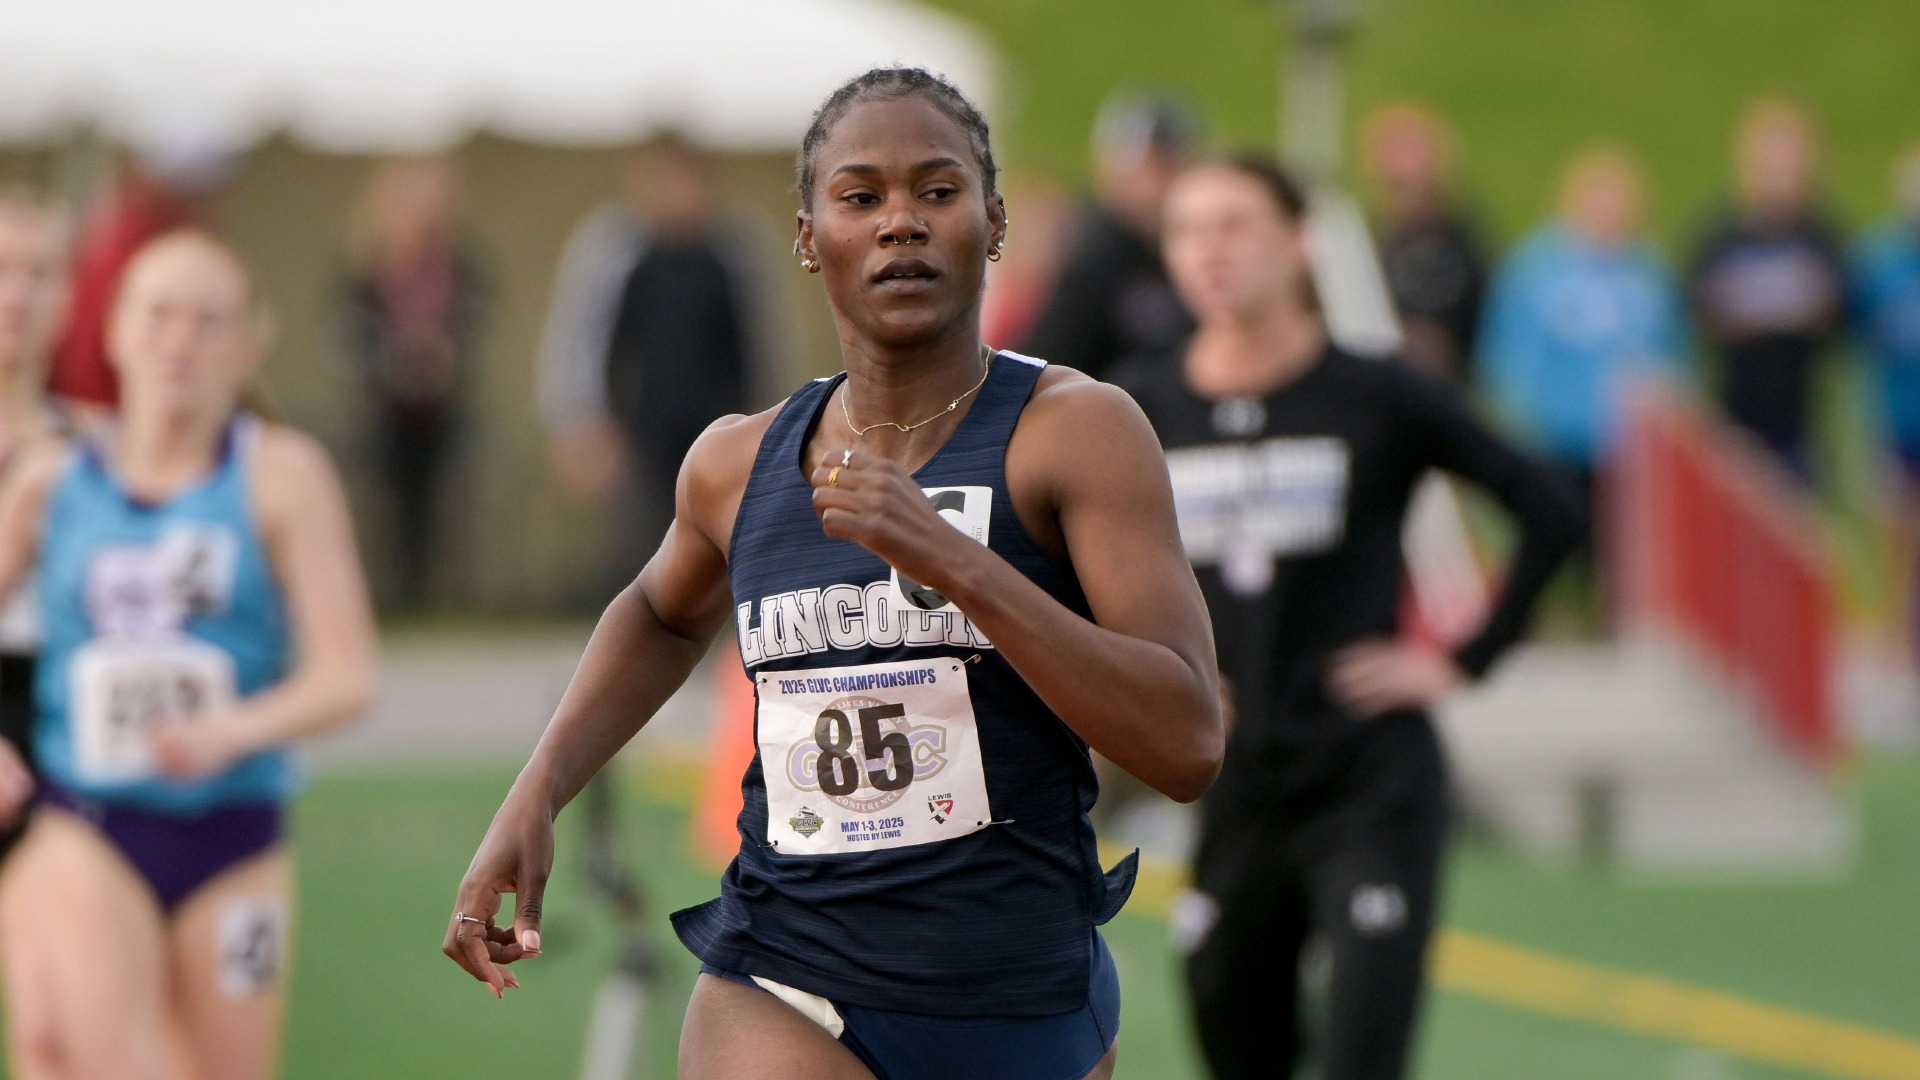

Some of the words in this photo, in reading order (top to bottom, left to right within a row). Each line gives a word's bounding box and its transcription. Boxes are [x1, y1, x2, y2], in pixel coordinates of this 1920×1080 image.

[779, 679, 806, 694] 2025
[807, 677, 832, 693] GLVC
[833, 668, 936, 692] CHAMPIONSHIPS
[837, 700, 864, 709] LAKES
[786, 724, 948, 793] GC
[815, 702, 914, 797] 85
[836, 790, 900, 811] CONFERENCE
[928, 792, 952, 801] LEWIS
[841, 821, 860, 832] MAY
[861, 820, 878, 831] 1-3,
[878, 816, 904, 830] 2025
[847, 833, 870, 842] HOSTED
[871, 832, 880, 841] BY
[881, 830, 902, 839] LEWIS
